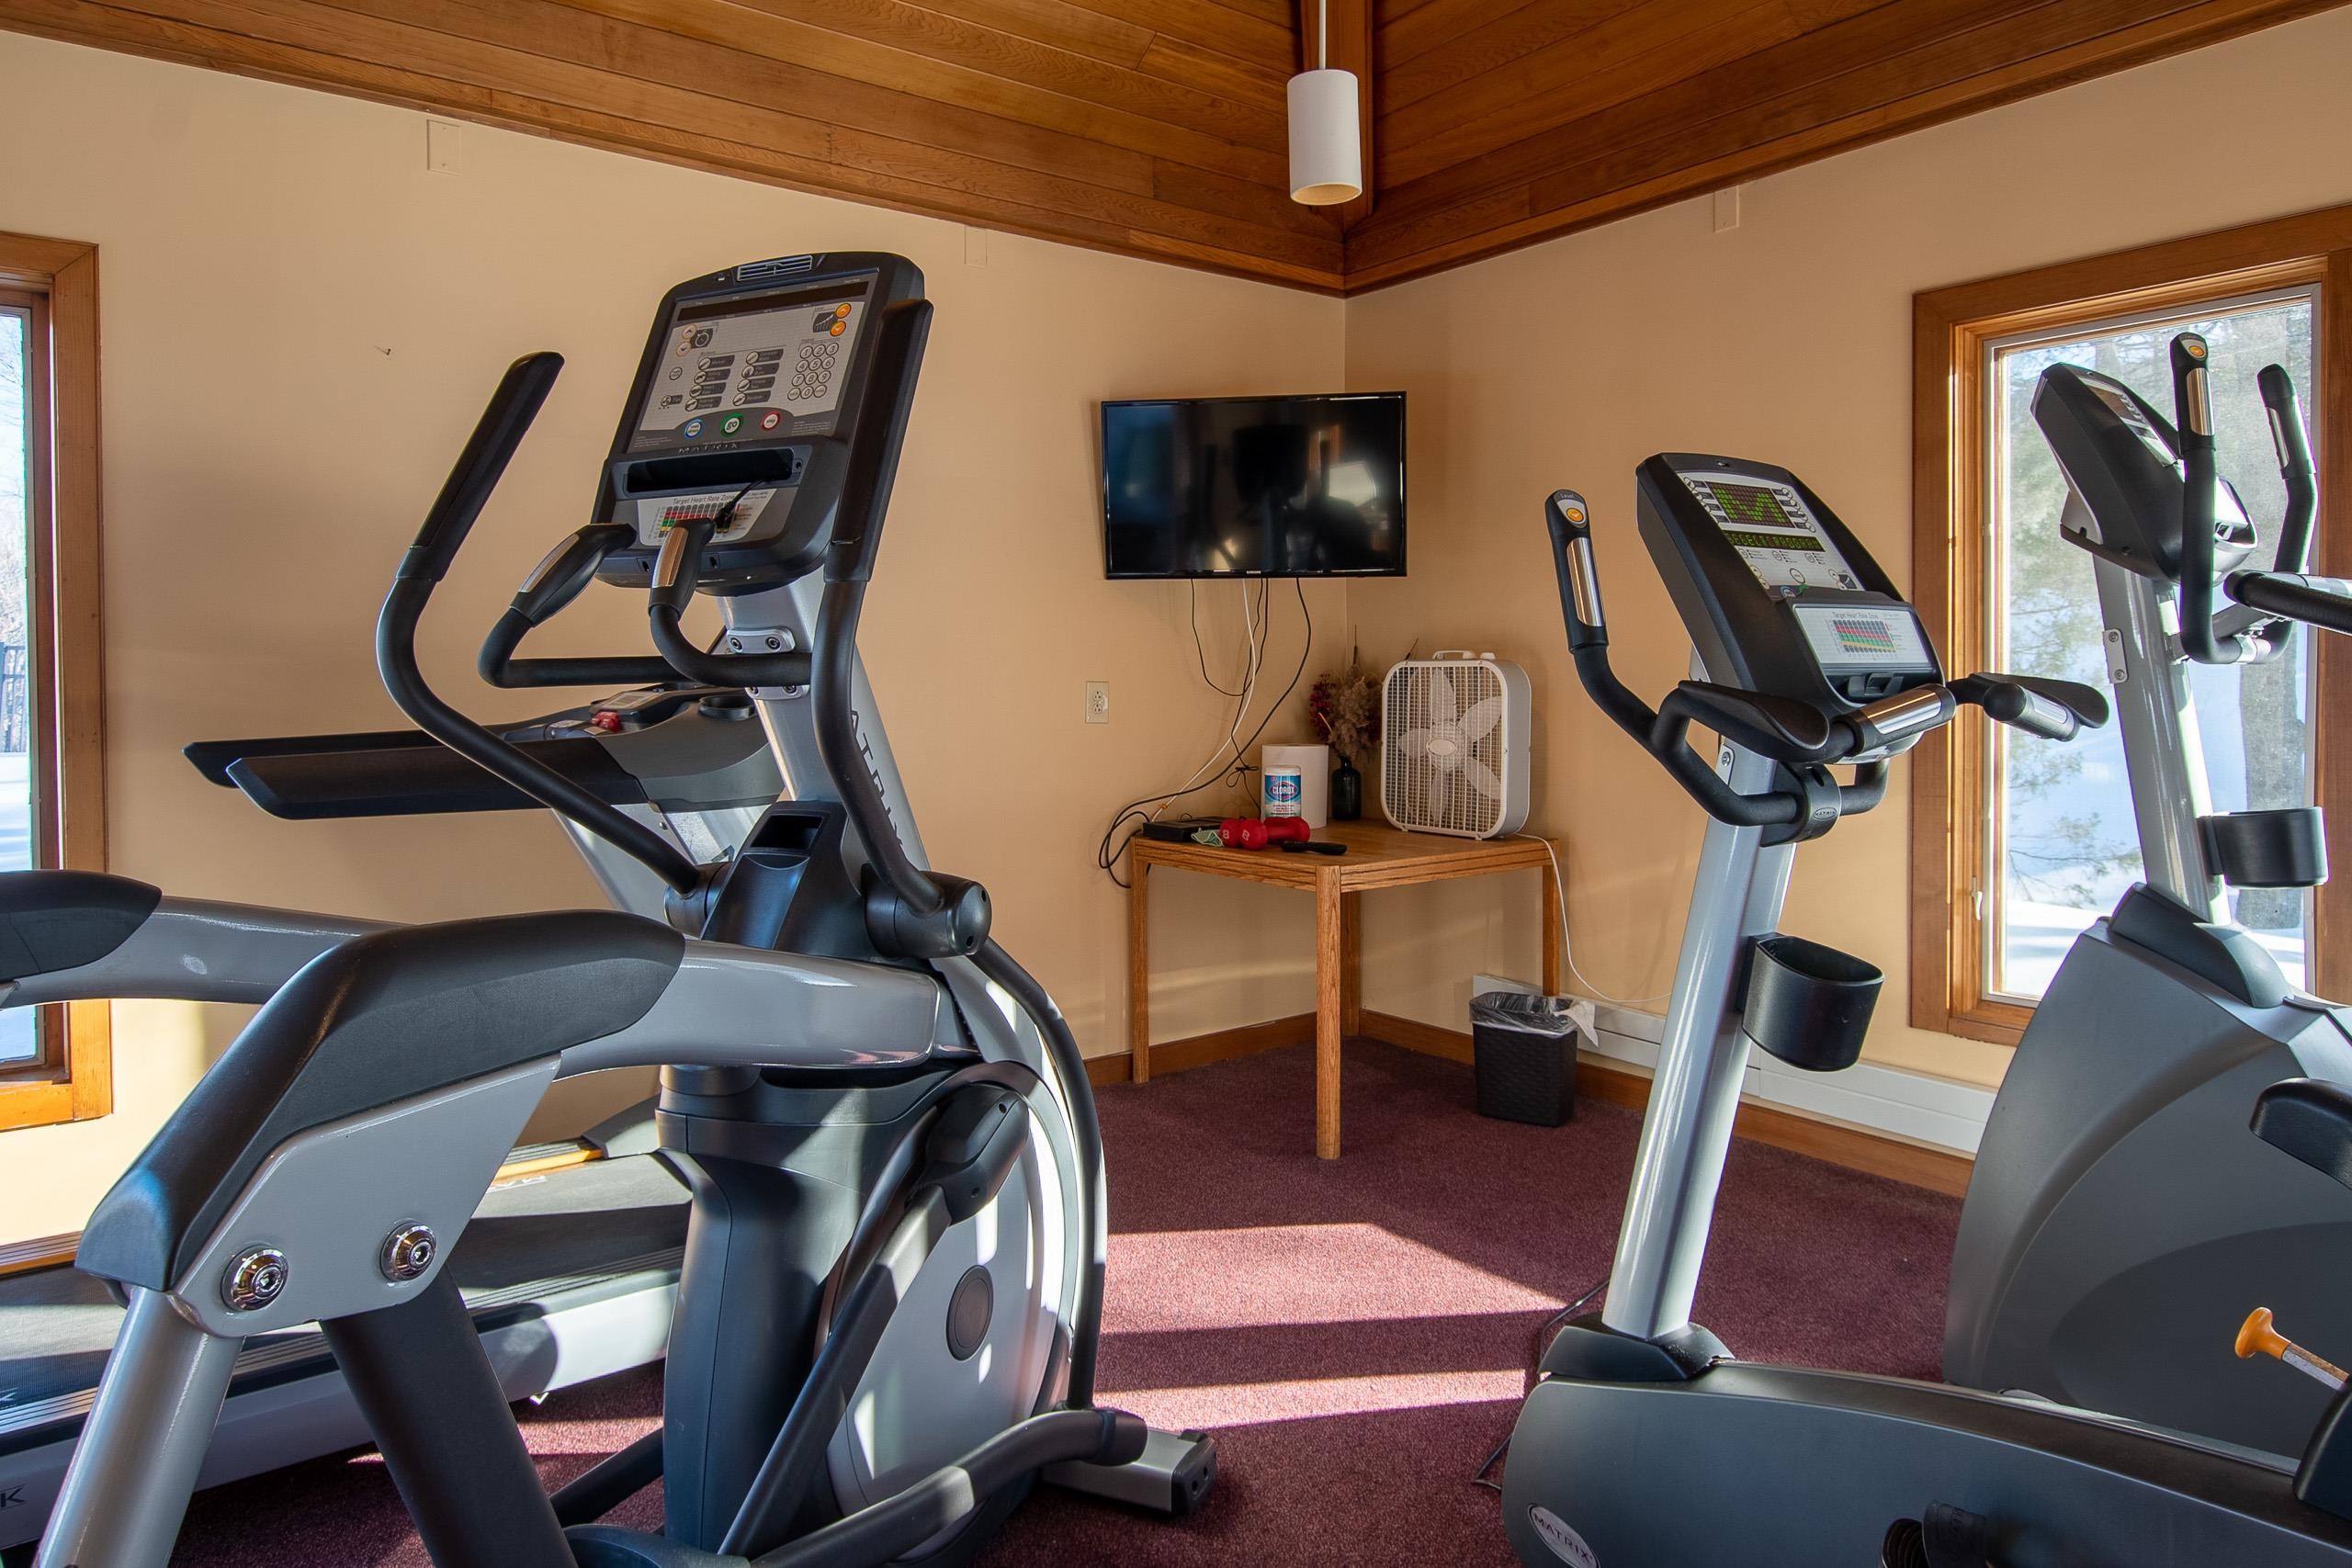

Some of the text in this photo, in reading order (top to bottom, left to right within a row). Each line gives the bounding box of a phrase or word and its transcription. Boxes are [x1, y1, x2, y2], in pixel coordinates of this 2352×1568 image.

[726, 421, 739, 431] go
[1272, 785, 1295, 795] CLOROX
[1533, 1513, 1590, 1562] MATRIX
